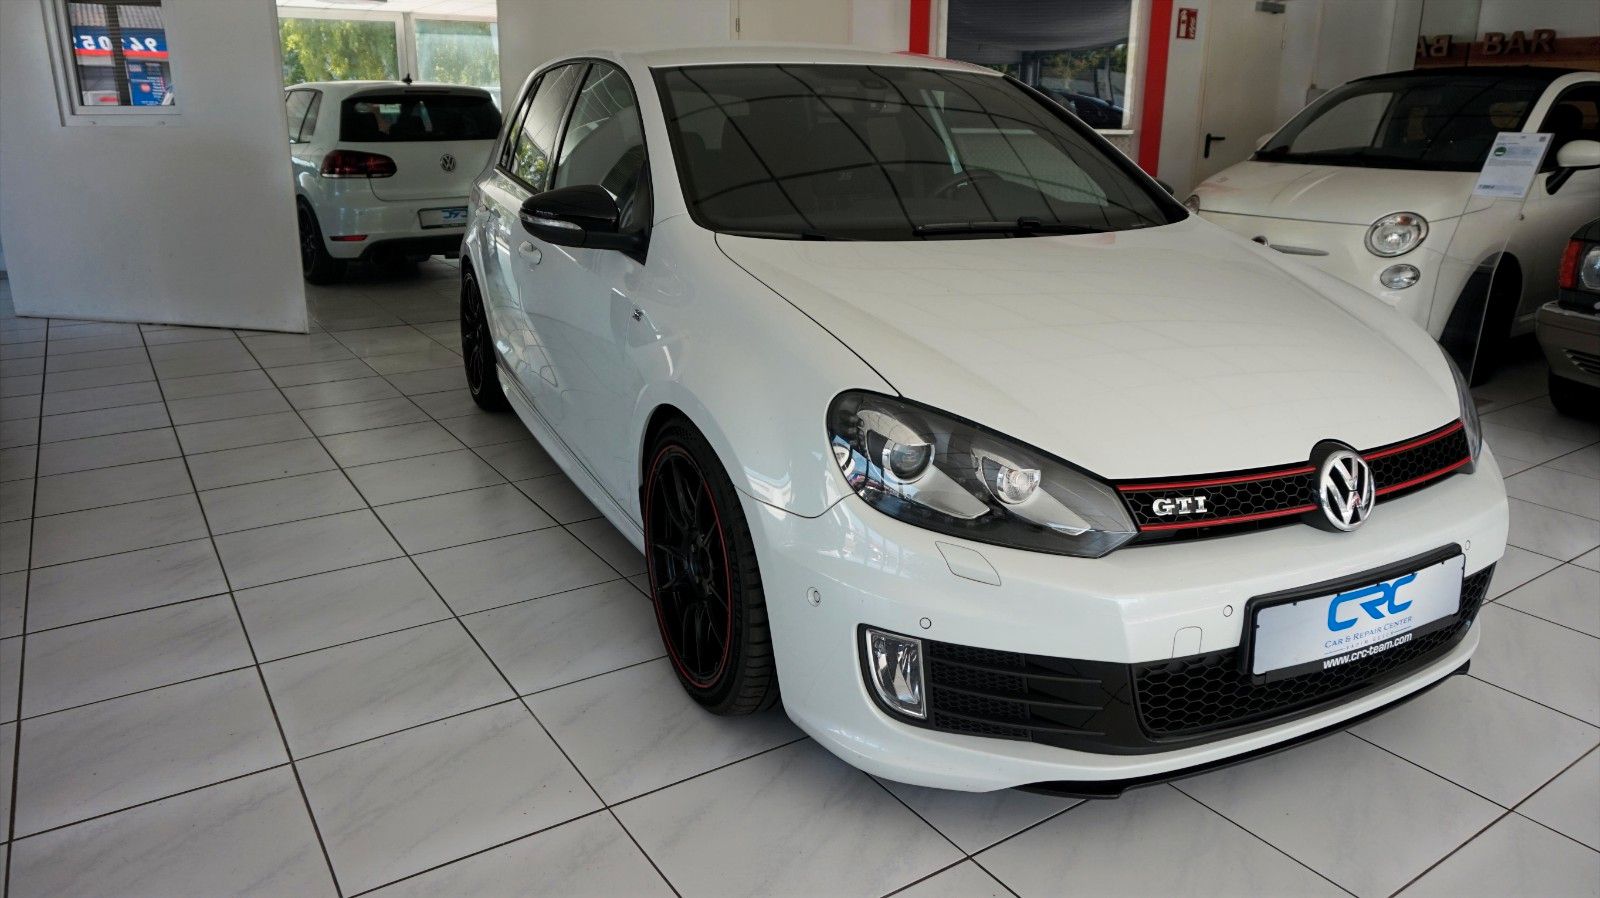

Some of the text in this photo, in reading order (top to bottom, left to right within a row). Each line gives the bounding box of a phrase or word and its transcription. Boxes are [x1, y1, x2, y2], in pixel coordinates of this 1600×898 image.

[1483, 29, 1556, 56] BAR
[1152, 495, 1208, 516] GTI
[1327, 573, 1417, 632] CRC
[1324, 638, 1344, 649] CAR
[1353, 625, 1382, 641] REPAIR
[1383, 616, 1413, 631] CENTER
[1323, 633, 1413, 669] www.crc-team.com
